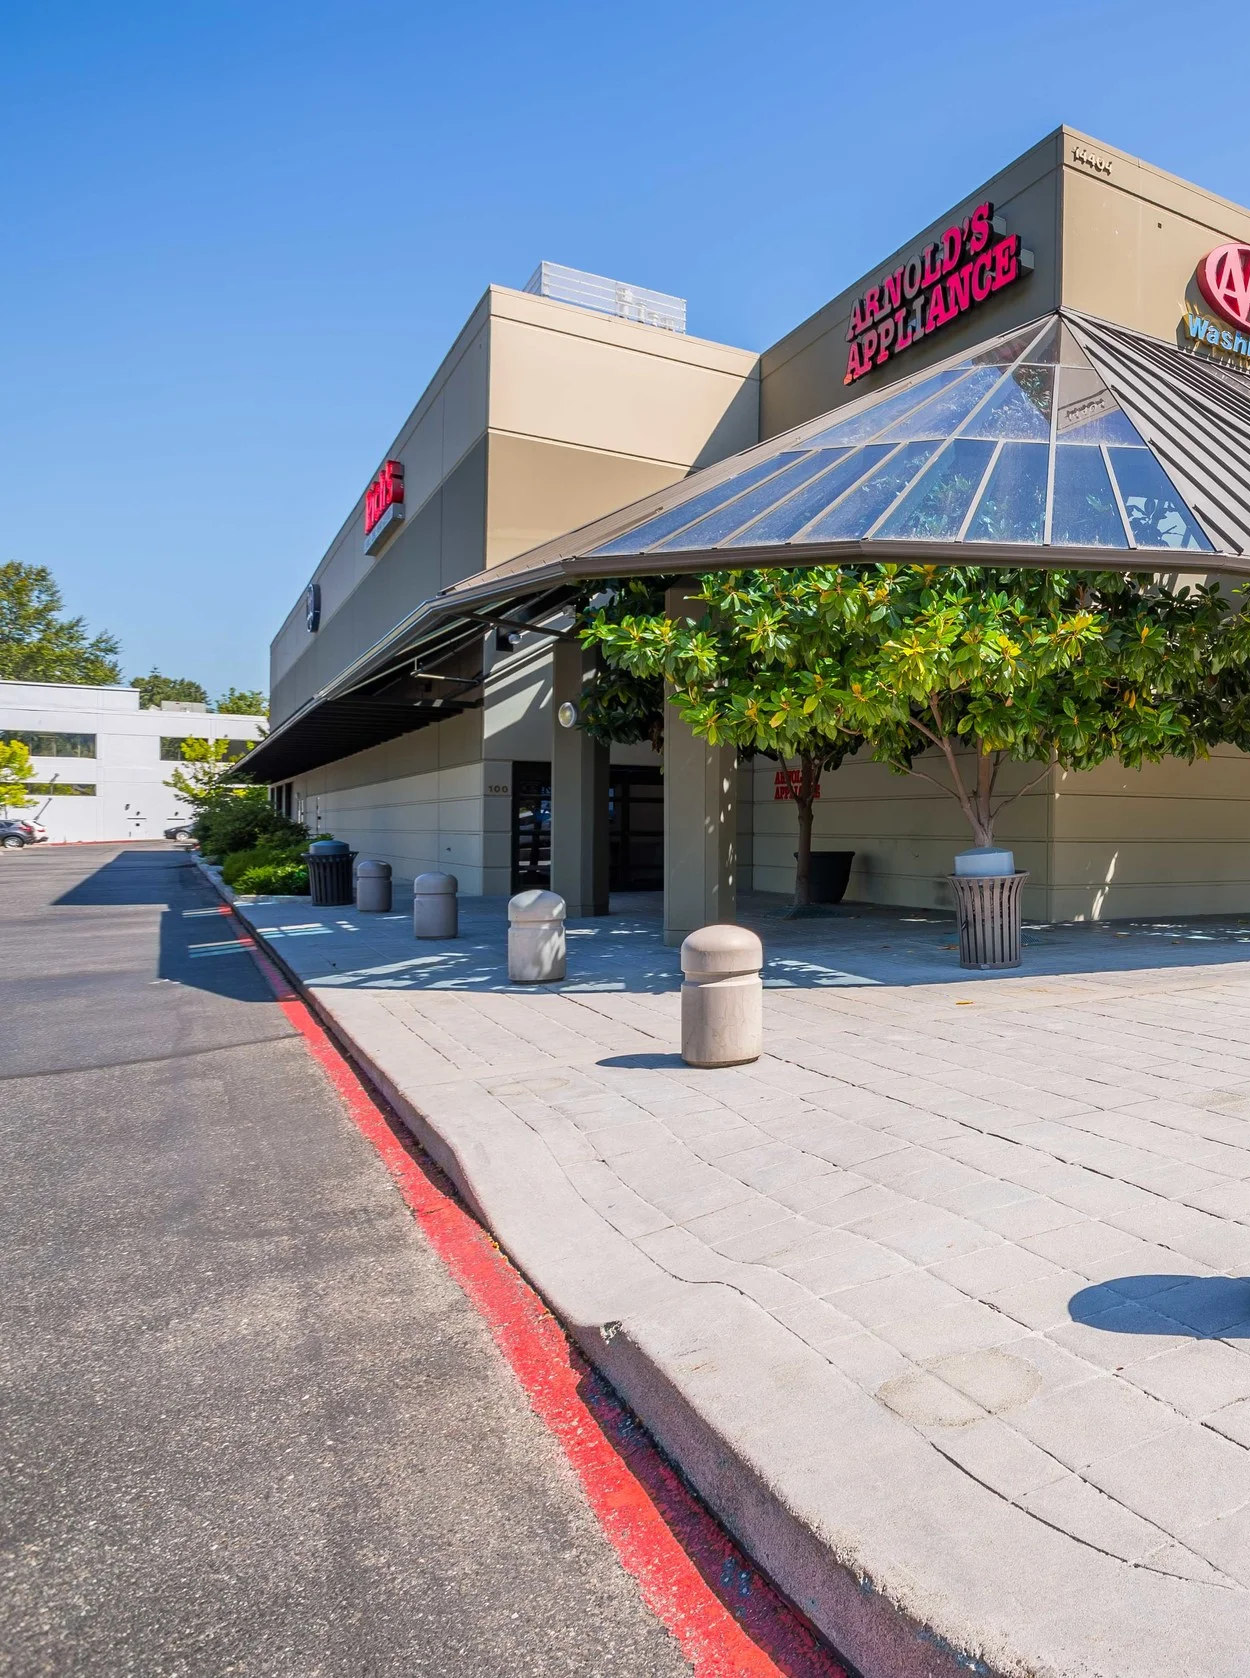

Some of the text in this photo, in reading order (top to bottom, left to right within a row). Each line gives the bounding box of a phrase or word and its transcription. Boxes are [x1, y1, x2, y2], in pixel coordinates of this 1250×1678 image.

[1072, 147, 1112, 174] 14404
[844, 233, 1018, 385] APPLIANCE
[846, 201, 992, 341] ARNOLD'S
[487, 785, 508, 793] 100
